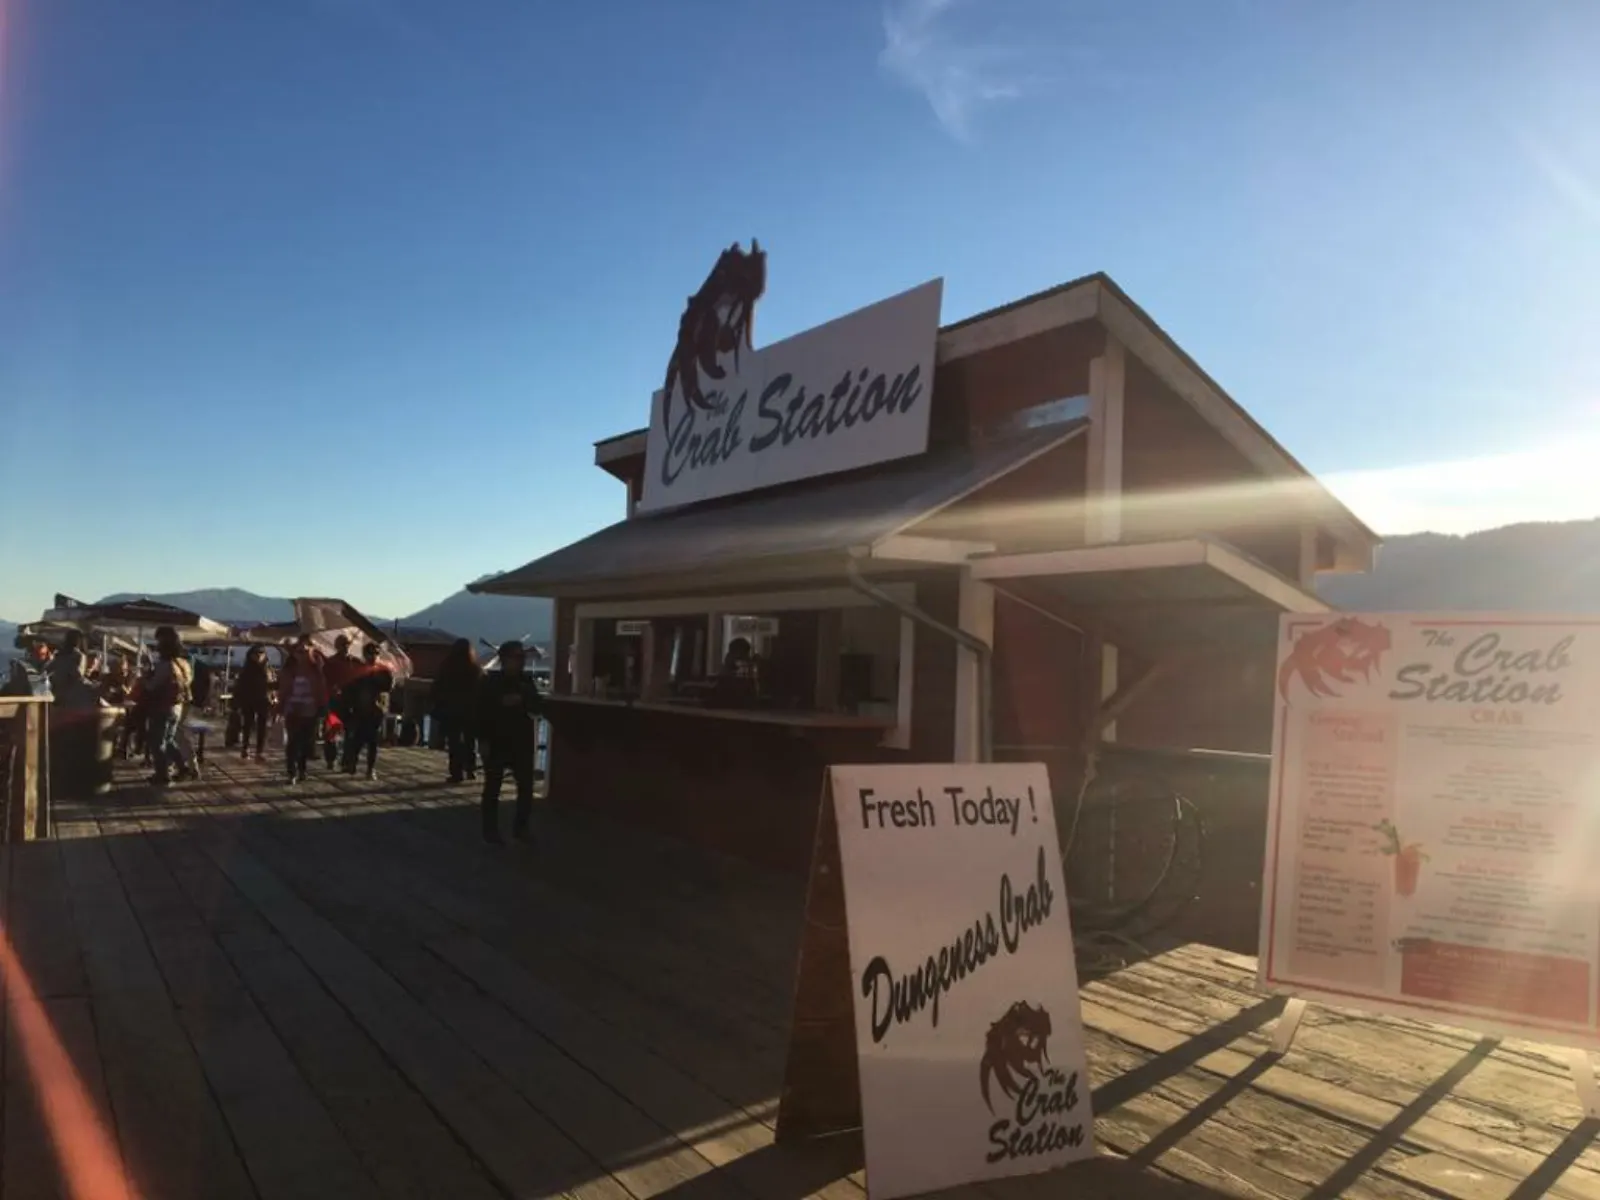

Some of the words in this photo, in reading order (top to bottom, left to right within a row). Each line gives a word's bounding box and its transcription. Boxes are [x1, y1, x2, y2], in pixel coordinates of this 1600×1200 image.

[662, 389, 745, 487] Crab
[749, 364, 924, 454] Station
[1421, 629, 1455, 647] The
[1453, 631, 1577, 677] Crab
[1387, 663, 1564, 705] Station
[858, 787, 936, 829] Fresh
[862, 912, 999, 1044] Dungeness
[1000, 845, 1054, 954] Crab
[1016, 1071, 1079, 1127] Crab
[1043, 1069, 1067, 1087] The
[985, 1118, 1086, 1164] Station
